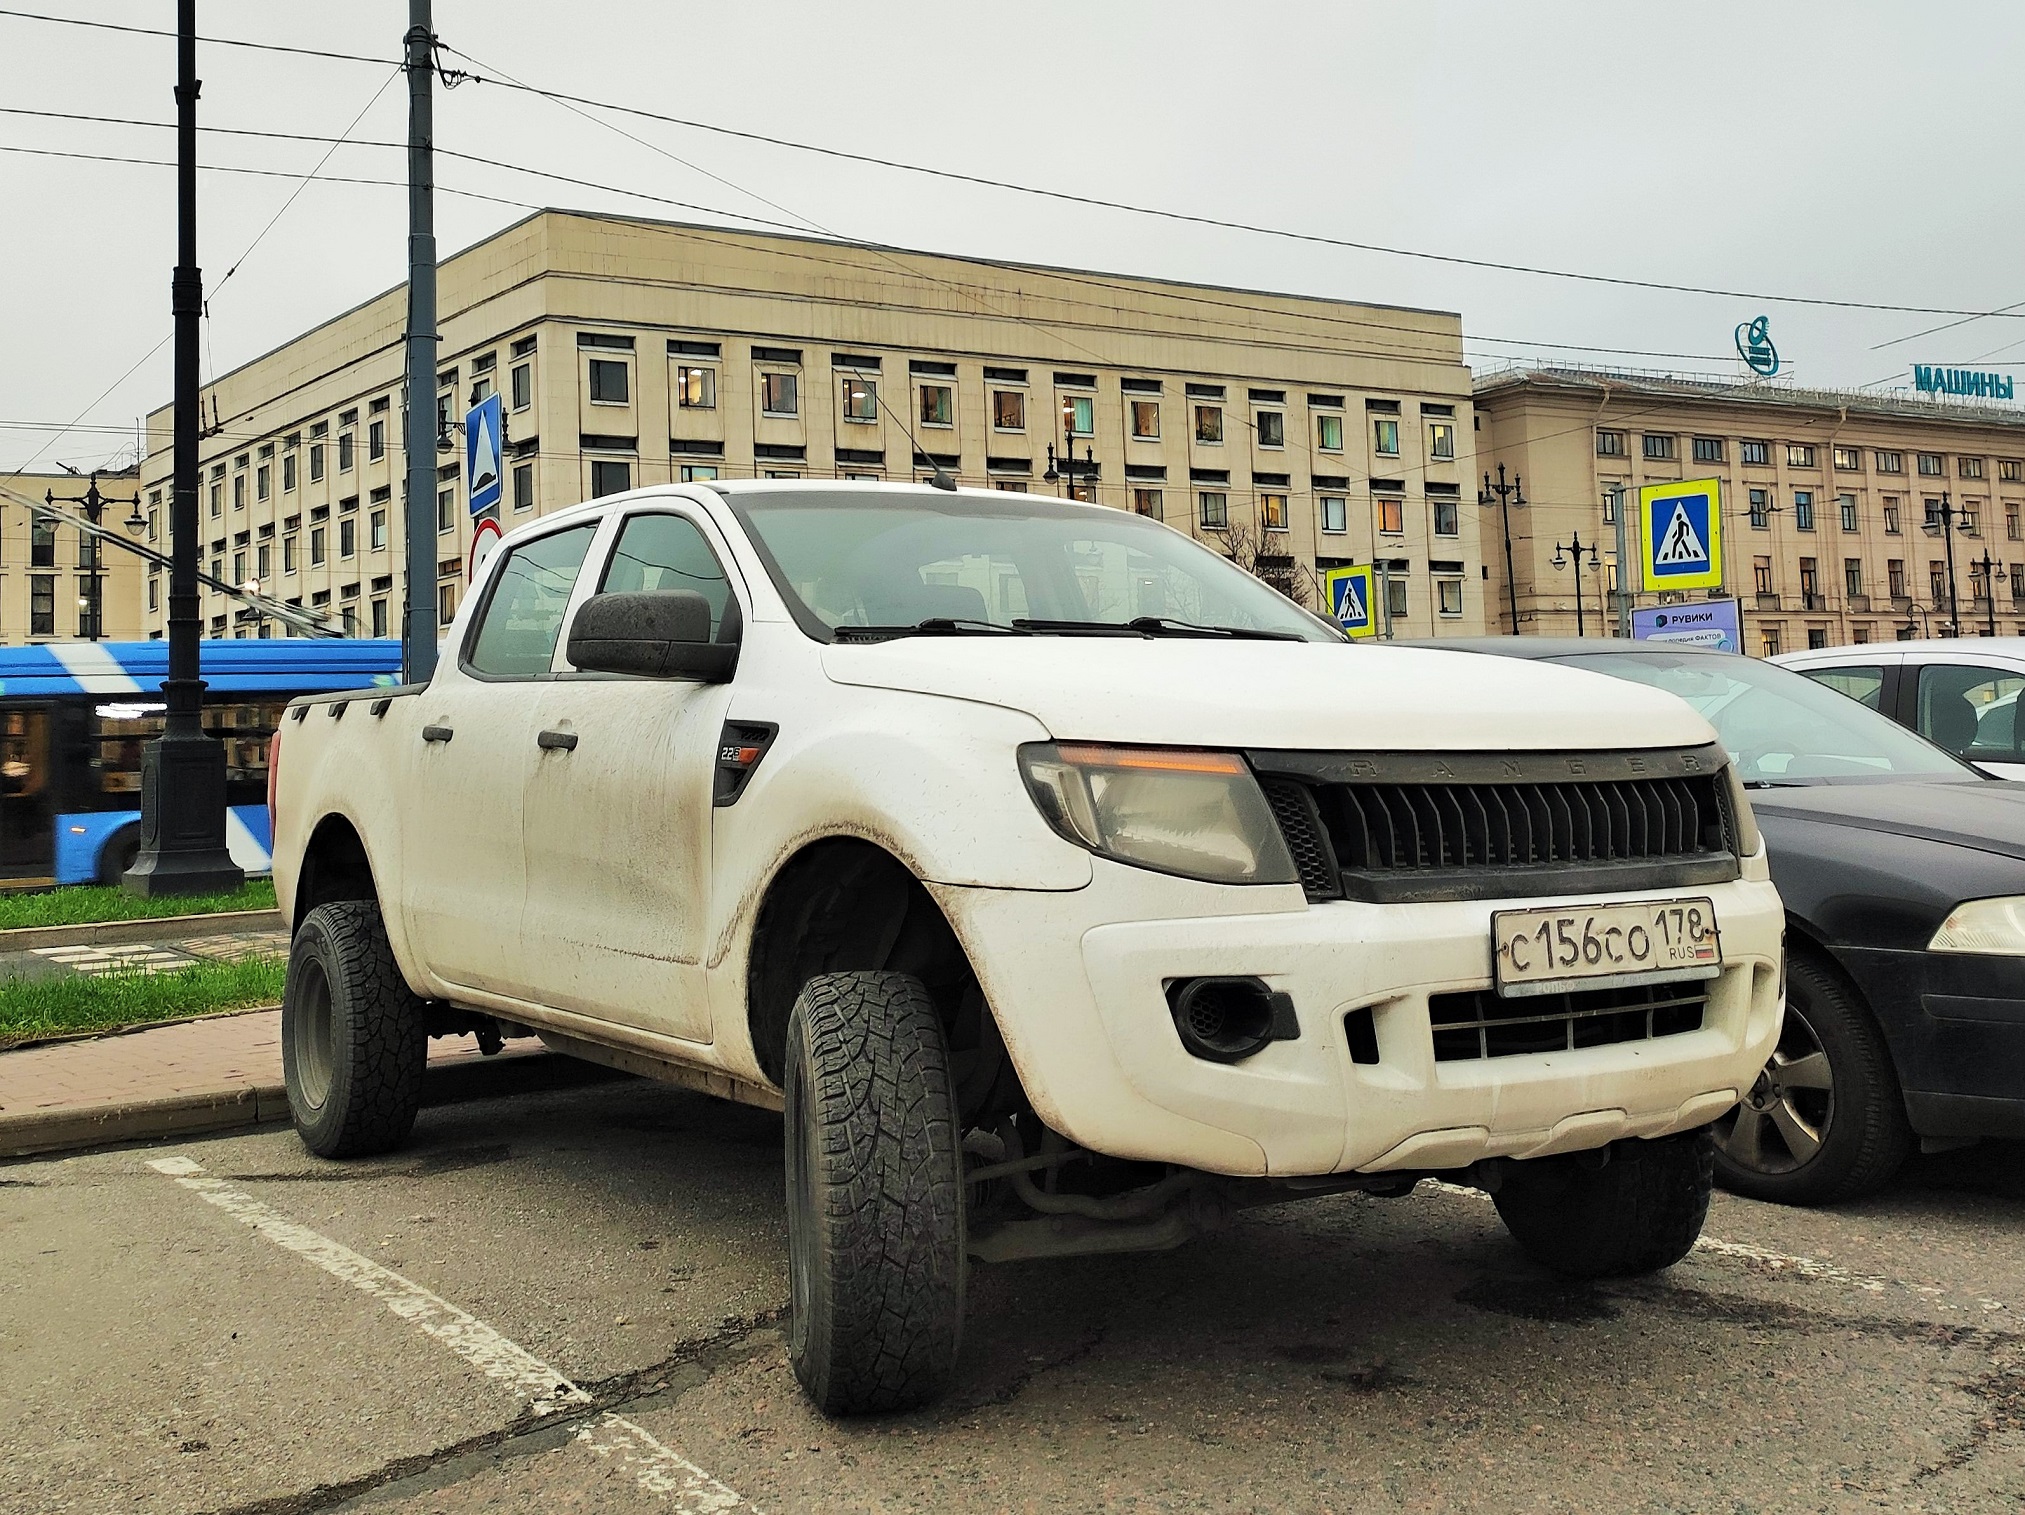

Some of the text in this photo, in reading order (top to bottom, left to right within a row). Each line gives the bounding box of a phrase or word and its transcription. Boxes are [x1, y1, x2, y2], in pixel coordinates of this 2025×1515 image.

[1914, 364, 2014, 400] МАШИНЫ
[1671, 613, 1713, 625] РУВИКИ
[1350, 755, 1701, 778] RANGER
[1655, 907, 1705, 946] 178
[1669, 946, 1695, 961] RUS
